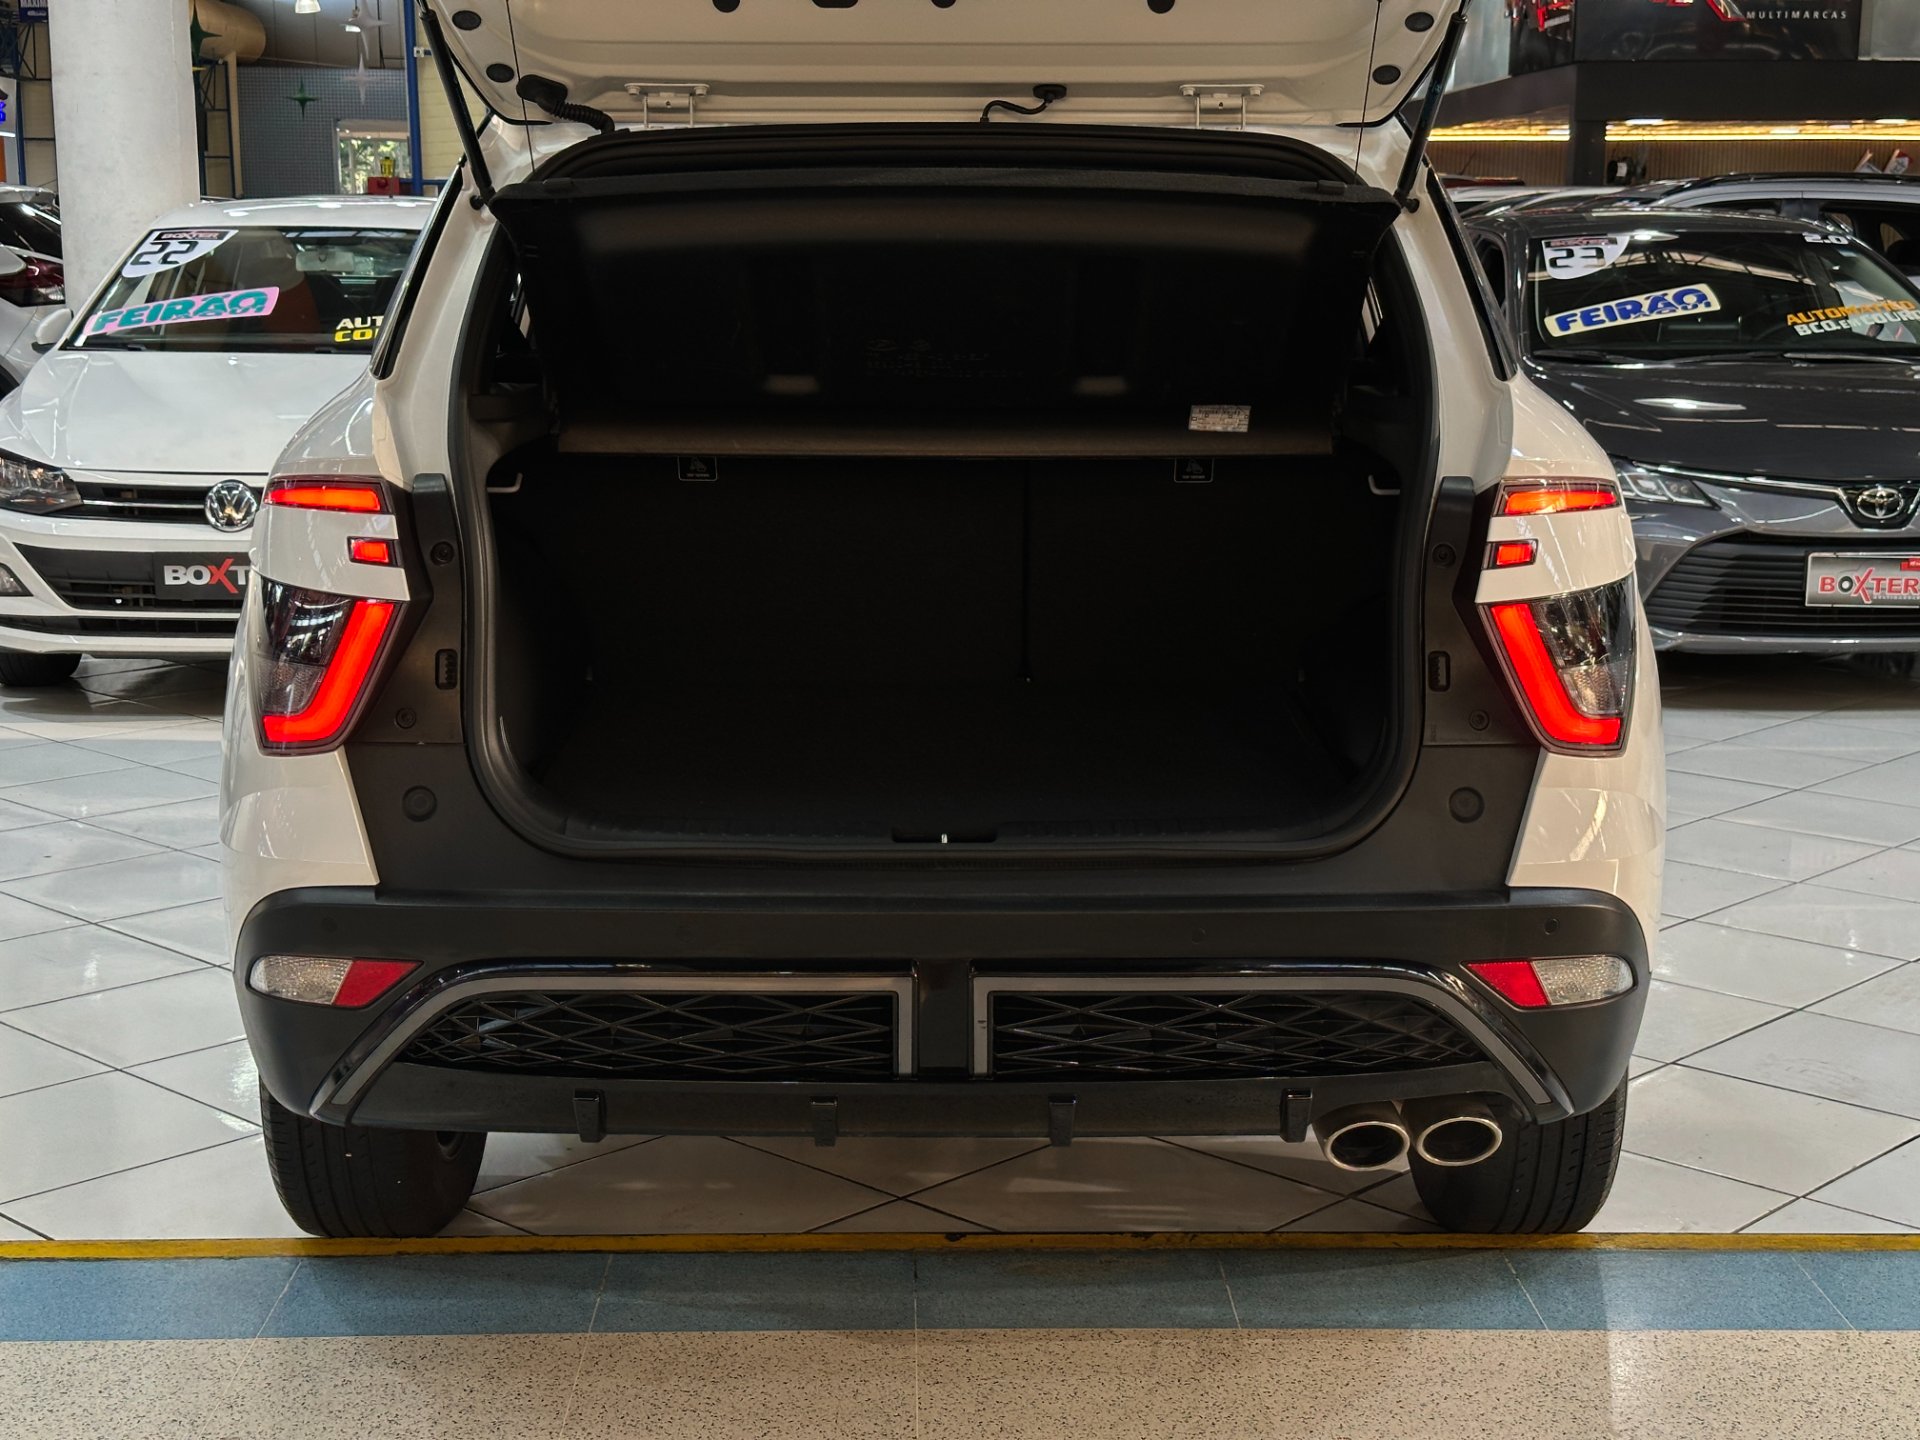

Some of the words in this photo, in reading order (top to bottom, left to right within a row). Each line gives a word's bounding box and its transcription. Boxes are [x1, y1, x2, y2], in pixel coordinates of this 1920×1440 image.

[1746, 10, 1848, 20] MULTIMARCAS
[1802, 232, 1849, 245] 2.0
[130, 241, 199, 265] 22
[1548, 247, 1606, 269] 23
[91, 290, 268, 332] FEIRÃO
[1555, 288, 1708, 332] FEIRÃO
[1818, 566, 1920, 604] BOXTER
